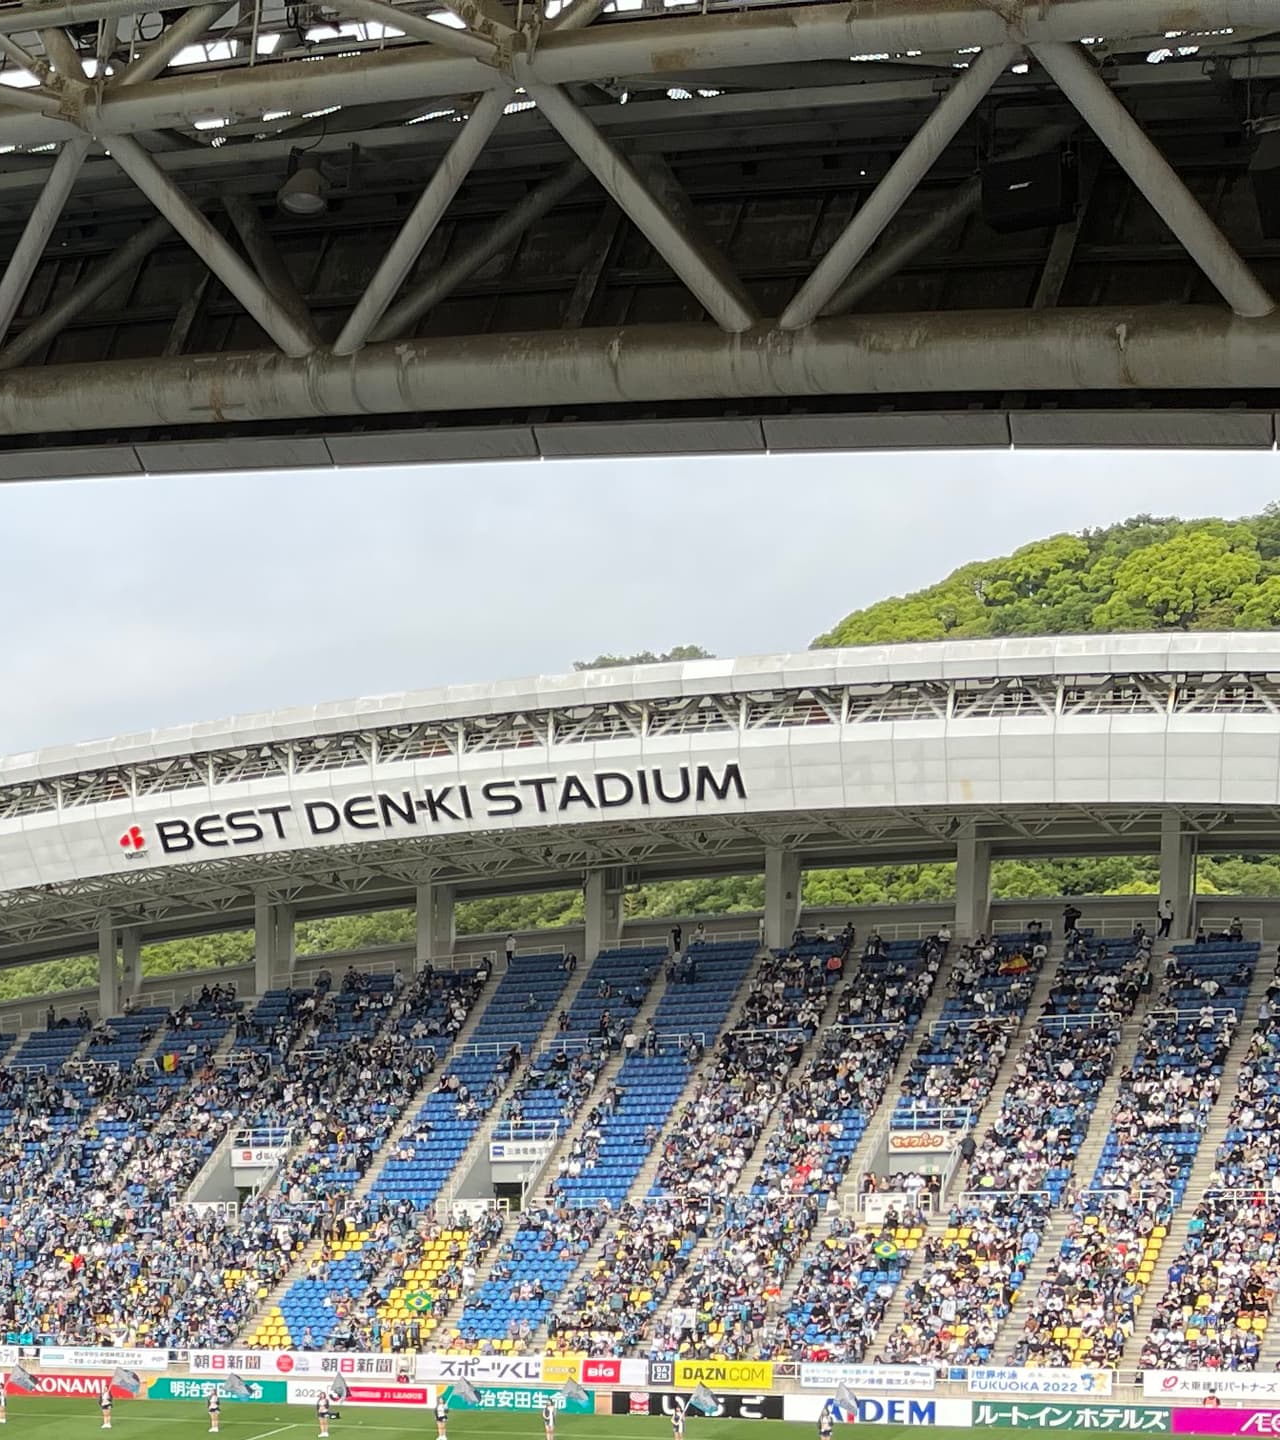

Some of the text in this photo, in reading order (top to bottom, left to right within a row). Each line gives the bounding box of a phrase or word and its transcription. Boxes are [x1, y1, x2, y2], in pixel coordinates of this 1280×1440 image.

[155, 804, 293, 854] BEST
[481, 763, 748, 817] STADIUM
[193, 1354, 262, 1370] 朝日新聞
[320, 1357, 393, 1373] 朝日新聞
[439, 1357, 541, 1379] スポーツくじ
[170, 1380, 264, 1400] 明治安田命
[295, 1389, 322, 1398] 2022
[971, 1381, 1078, 1392] FUKUOKA 2022
[477, 1389, 567, 1409] 治安田生命
